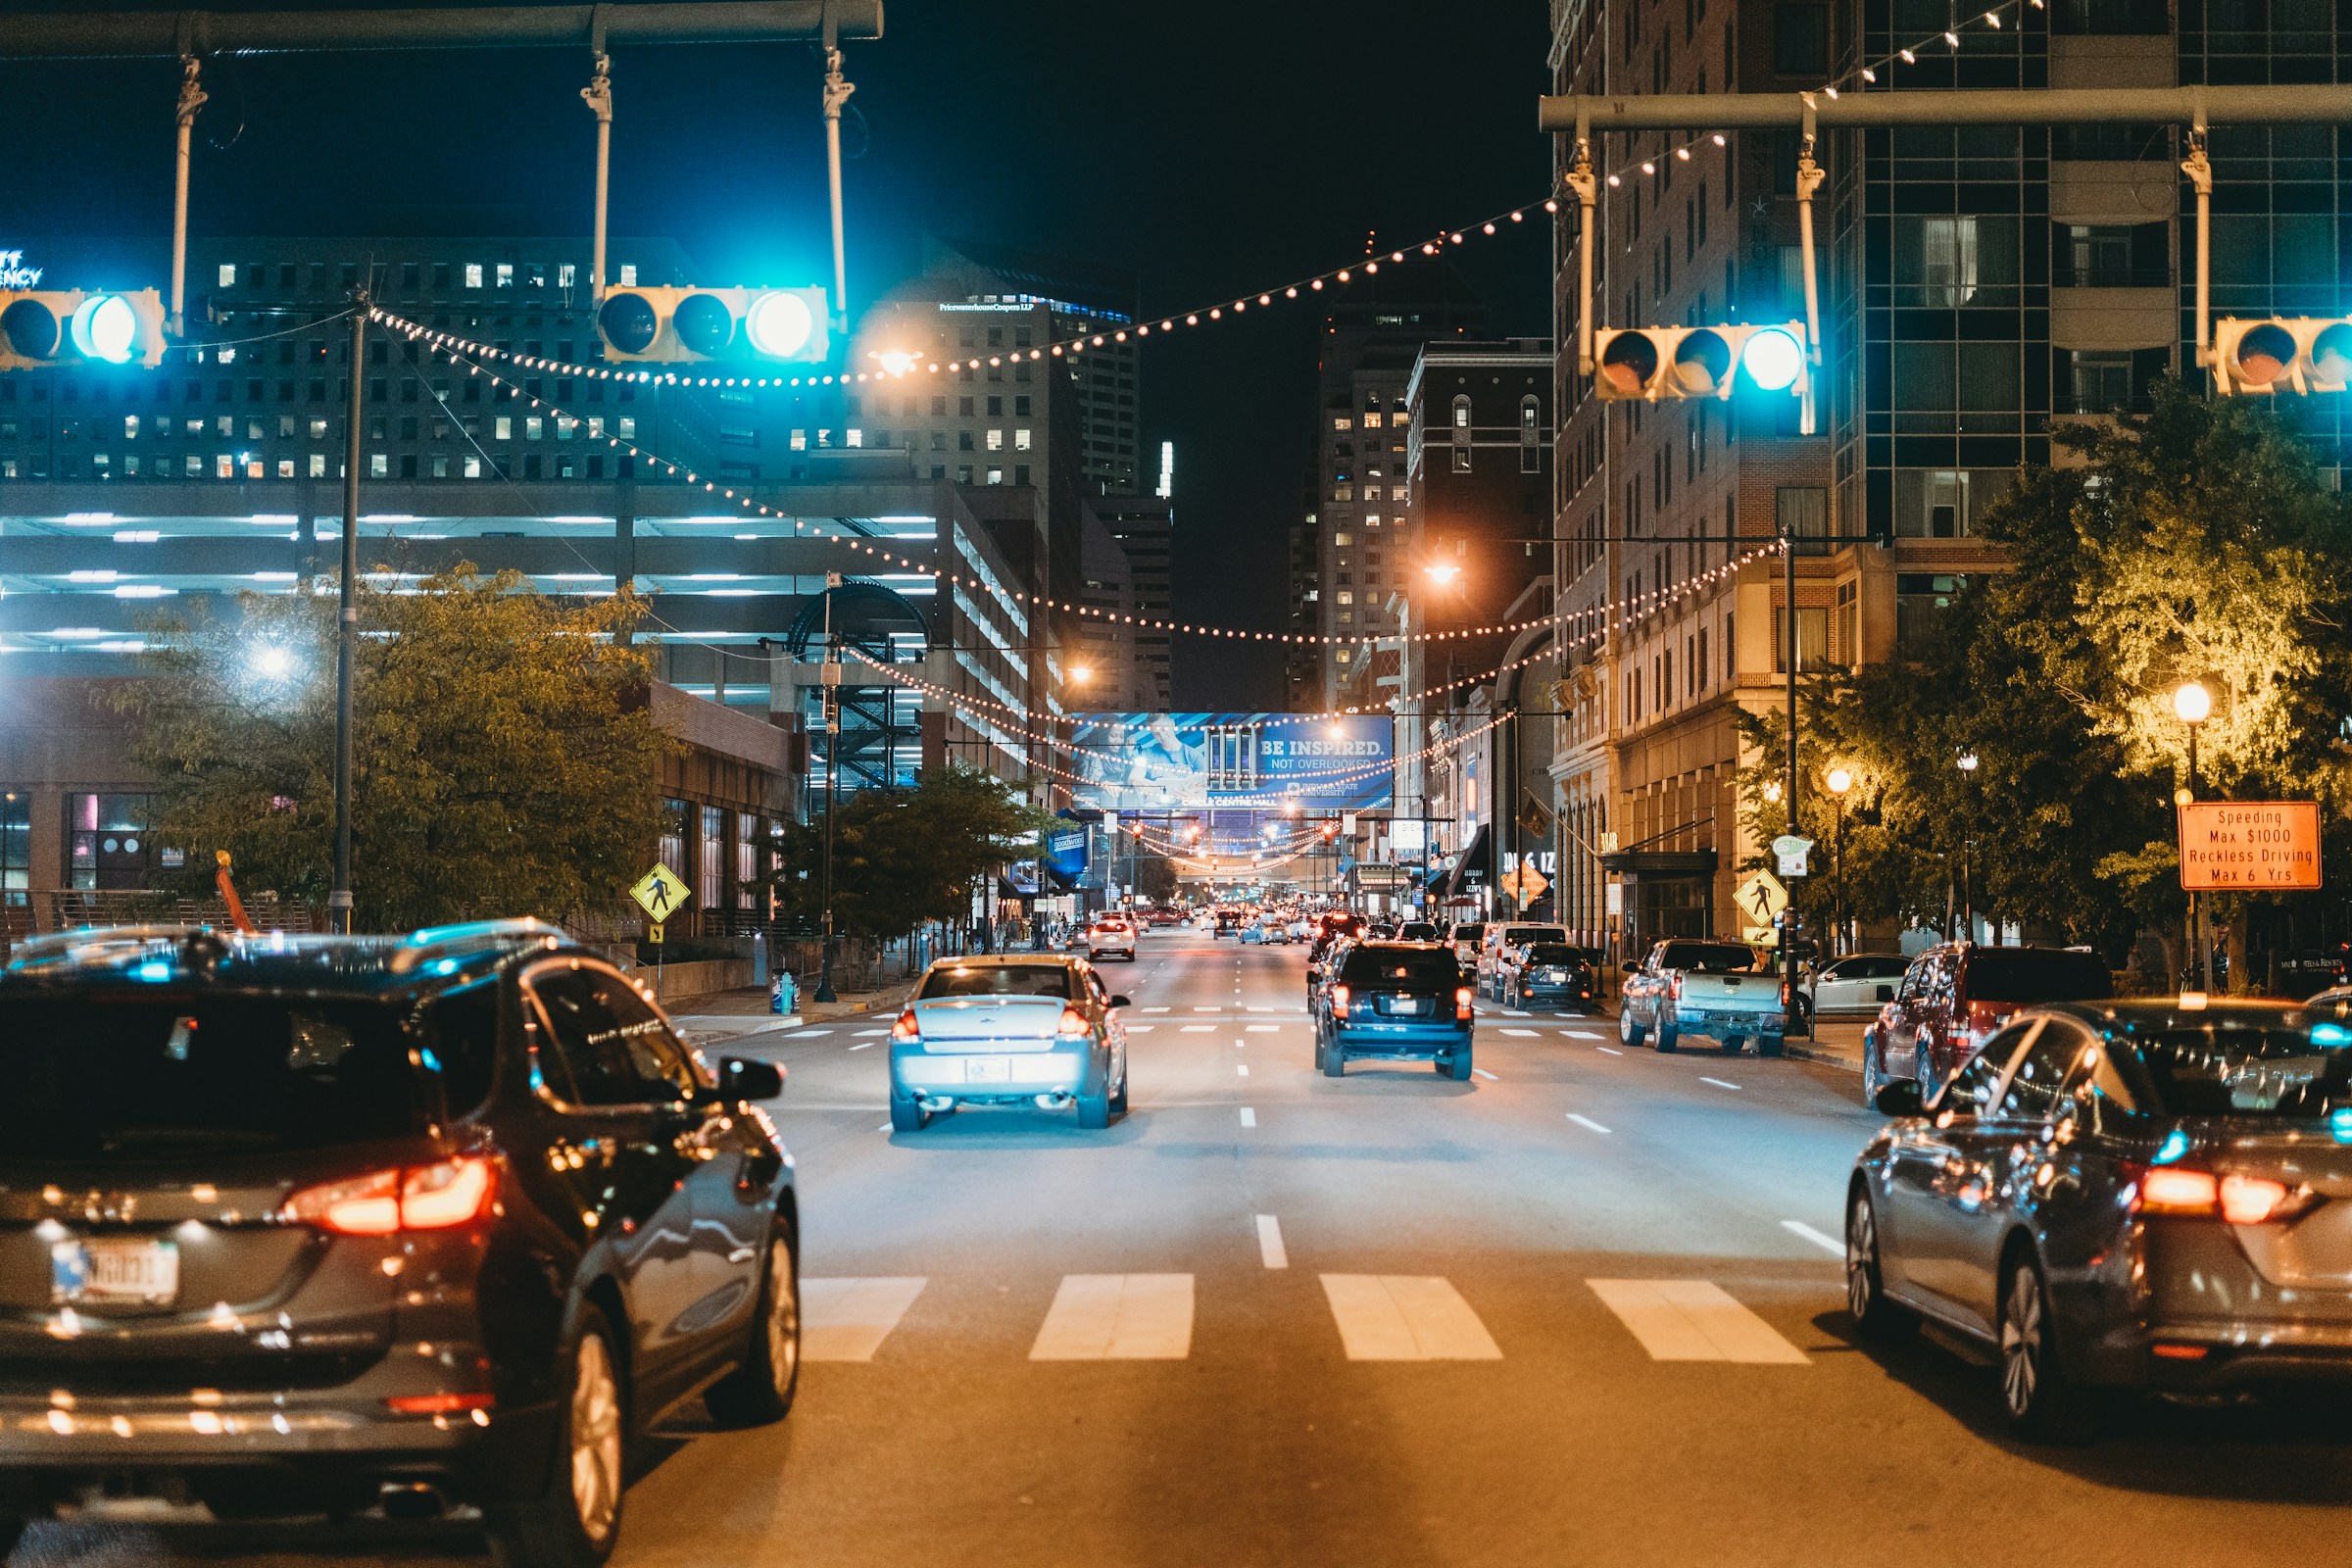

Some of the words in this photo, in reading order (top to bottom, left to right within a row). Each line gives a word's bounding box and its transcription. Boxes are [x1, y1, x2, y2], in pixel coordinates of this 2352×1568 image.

[939, 304, 1020, 313] PricewaterhouseCoopers
[1260, 741, 1284, 756] BE
[1290, 741, 1385, 756] INSPIRED.
[1271, 760, 1294, 769] NOT
[1298, 760, 1372, 769] OVERLOOKED
[2218, 810, 2281, 826] Speeding
[2210, 830, 2236, 844] Max
[2247, 829, 2291, 844] $1000
[2189, 850, 2254, 862] Reckless
[2261, 849, 2313, 866] Driving
[2211, 868, 2237, 882] Max
[2247, 868, 2256, 882] 6
[2267, 867, 2291, 881] Yrs
